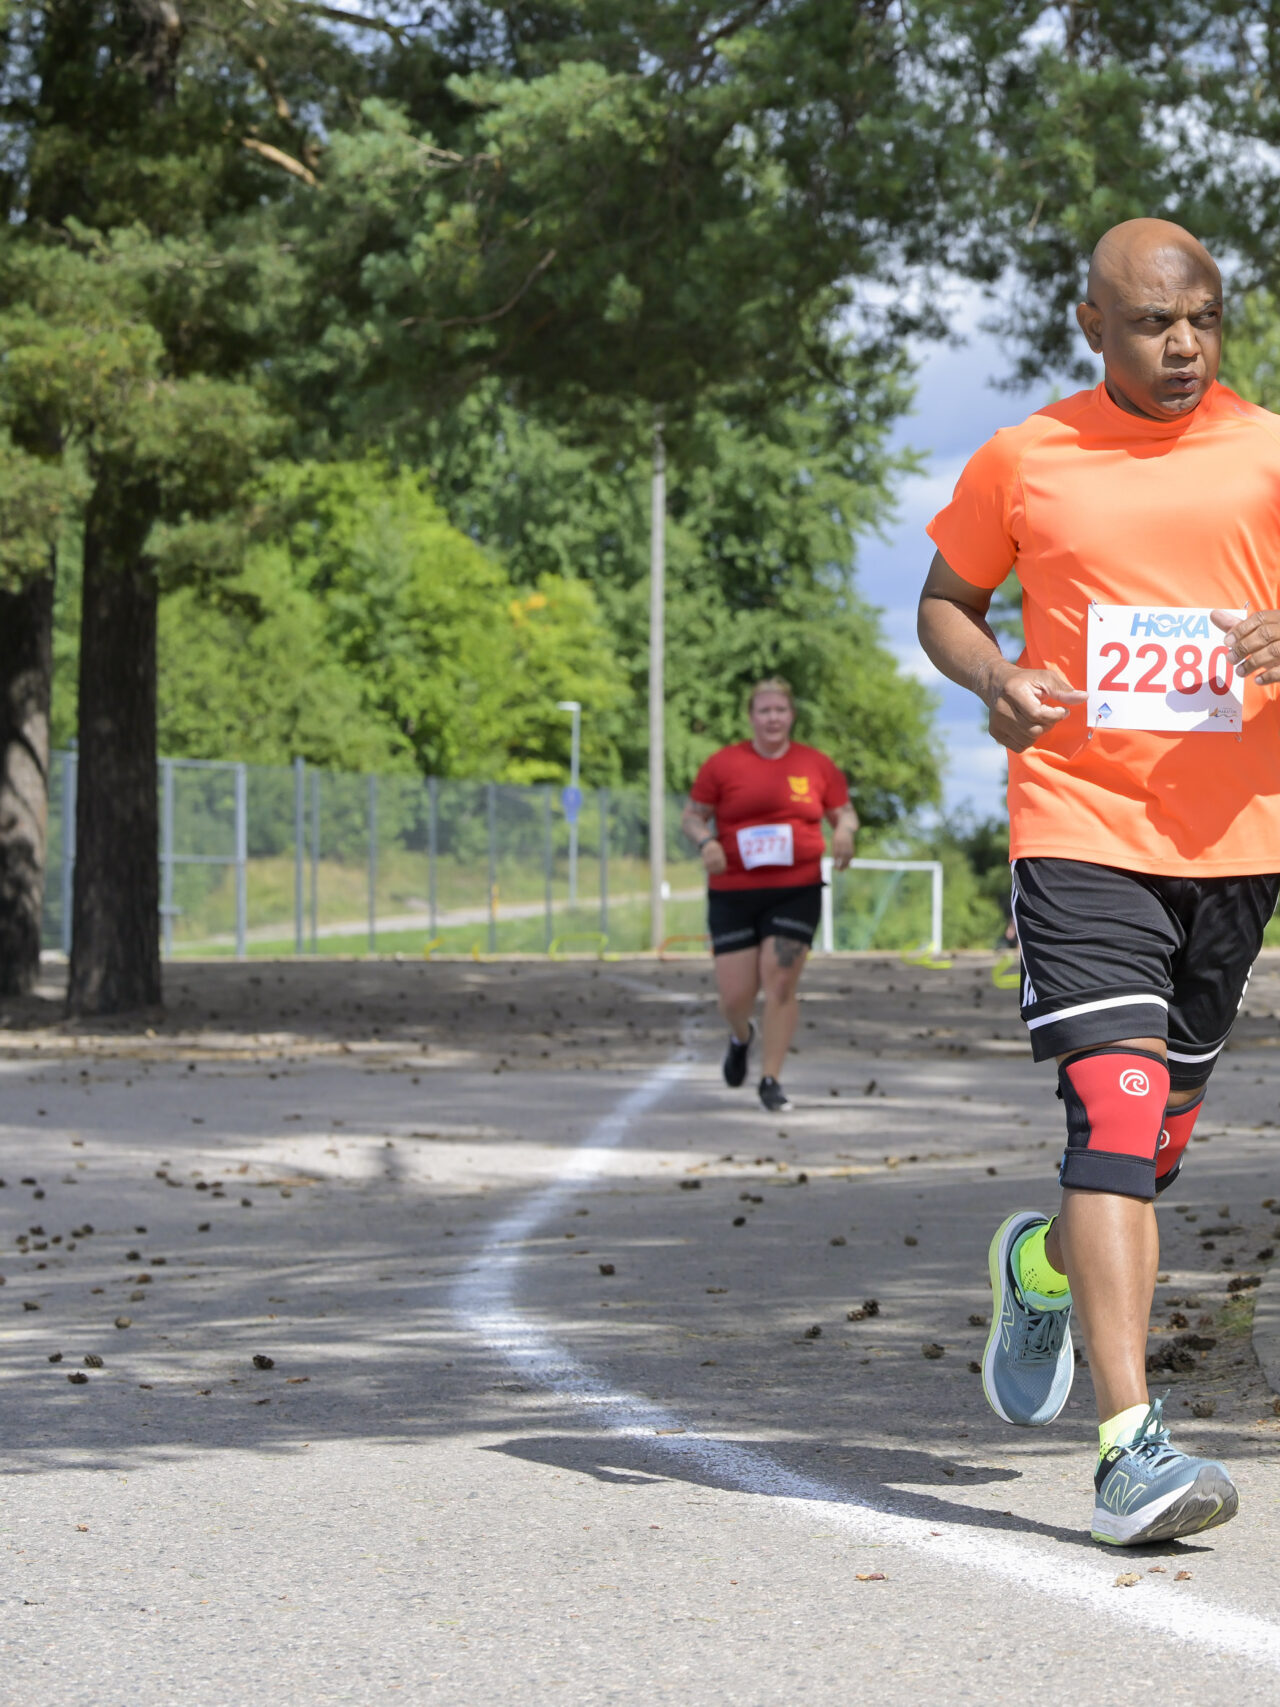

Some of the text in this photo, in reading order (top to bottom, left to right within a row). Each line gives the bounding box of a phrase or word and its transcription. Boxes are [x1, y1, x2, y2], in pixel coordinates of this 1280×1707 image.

[1130, 613, 1210, 638] HOKA
[1098, 642, 1234, 695] 2280
[742, 836, 787, 857] 2277
